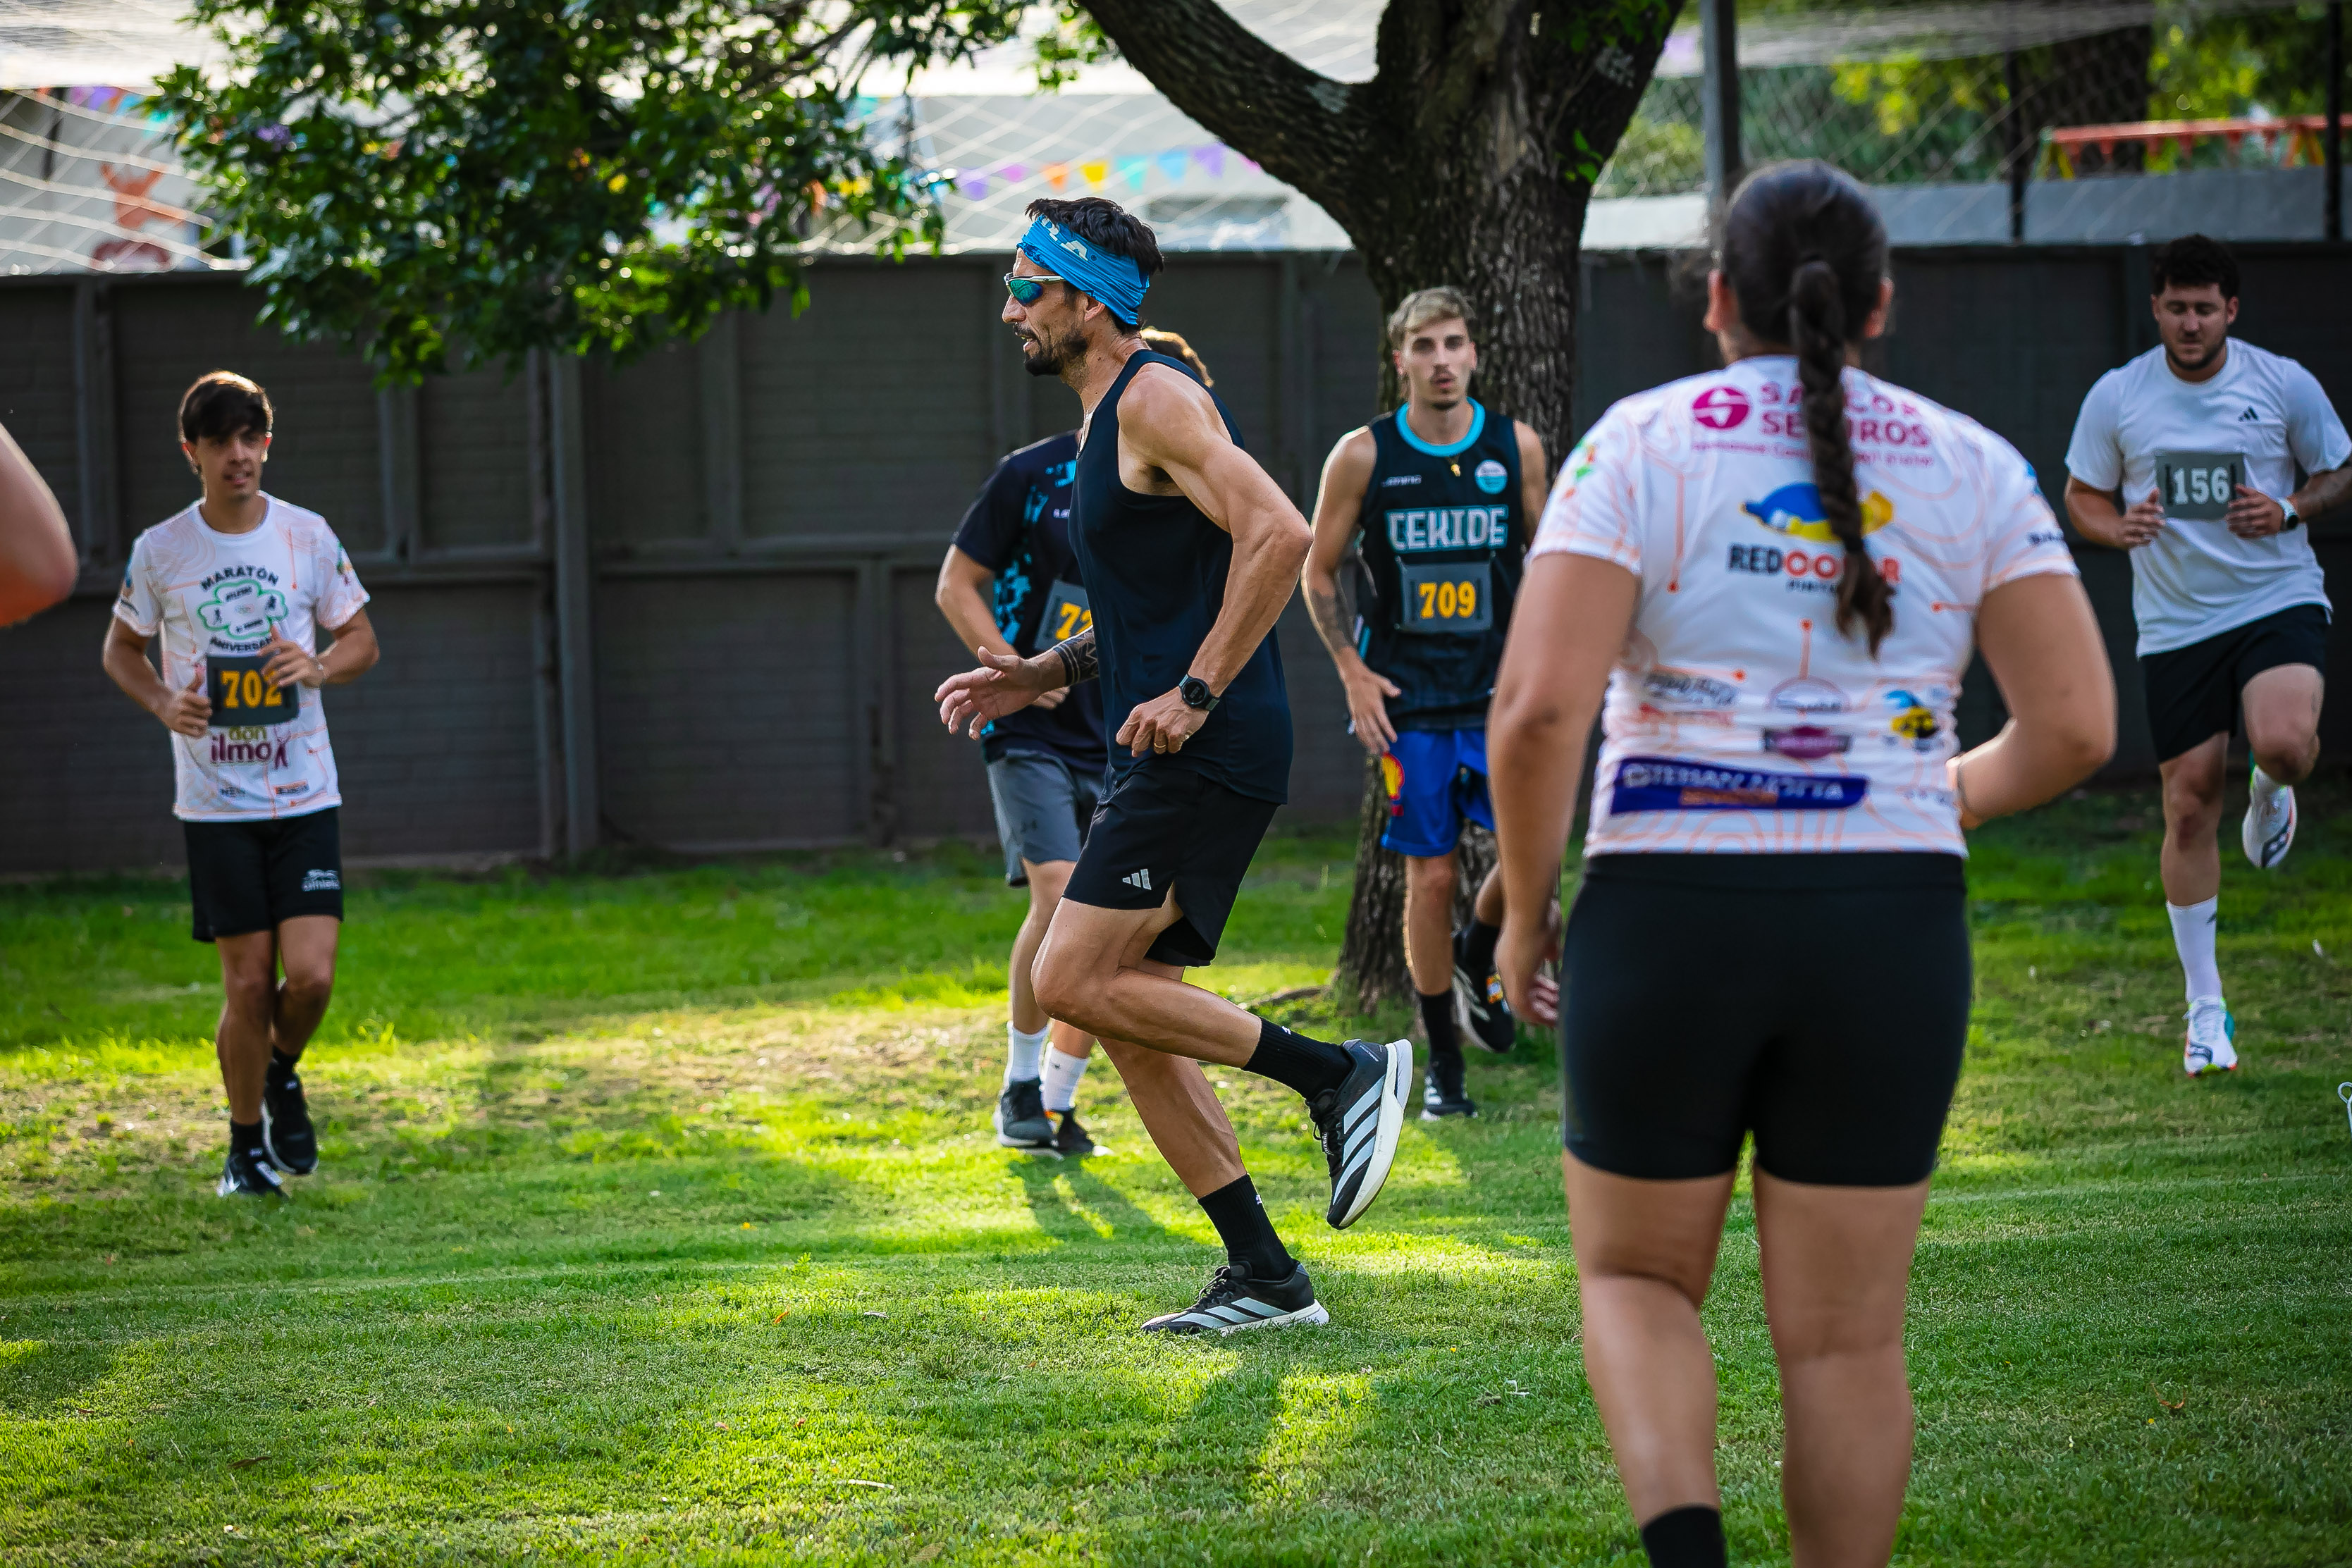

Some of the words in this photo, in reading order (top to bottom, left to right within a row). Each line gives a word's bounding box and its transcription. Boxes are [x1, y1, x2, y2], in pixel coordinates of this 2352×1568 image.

[1760, 382, 1920, 419] SACOR
[1760, 411, 1931, 447] SEROS
[2173, 467, 2230, 505] 156
[1386, 505, 1508, 553] CEKIDE
[1727, 541, 1901, 584] REDCOR
[1418, 581, 1476, 619] 709
[220, 669, 283, 709] 702
[210, 732, 273, 761] ilmo
